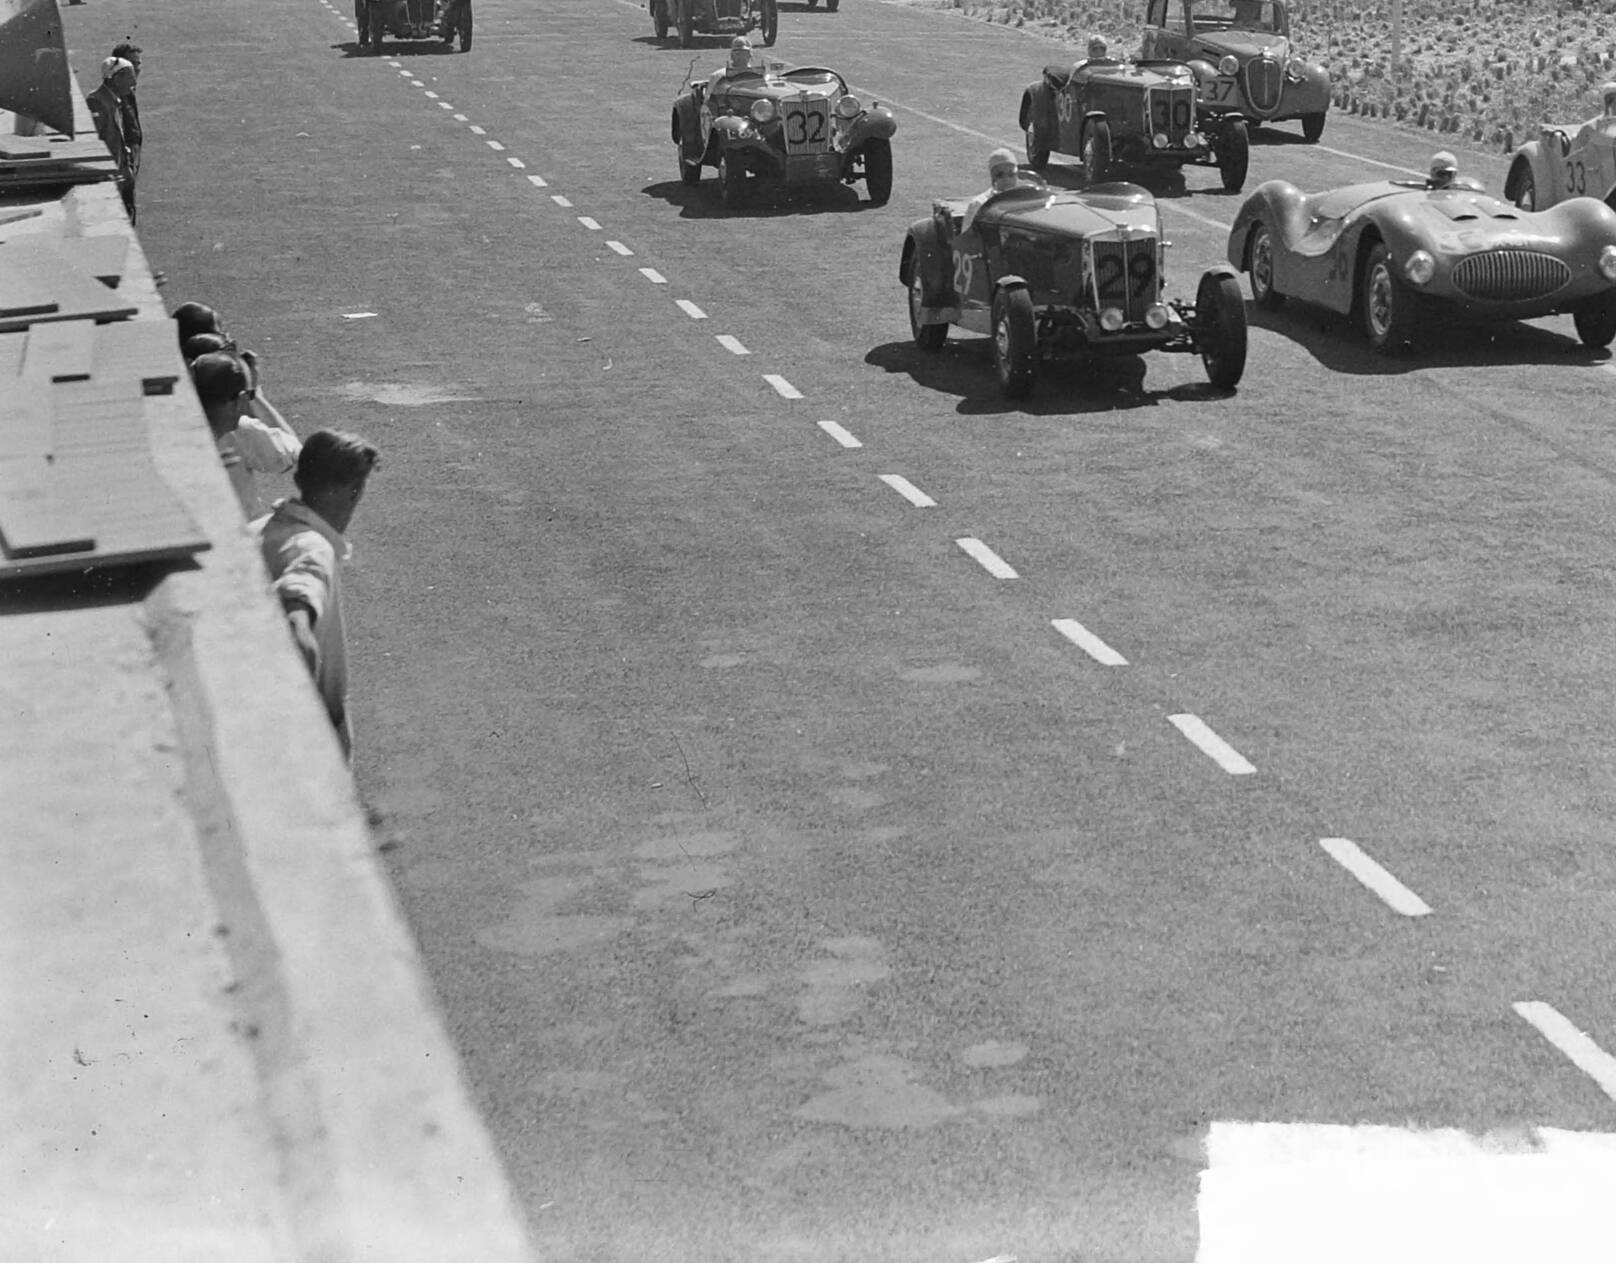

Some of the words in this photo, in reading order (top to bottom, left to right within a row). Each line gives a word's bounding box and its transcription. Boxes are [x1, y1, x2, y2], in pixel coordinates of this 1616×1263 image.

[1057, 92, 1072, 124] 30
[1205, 80, 1235, 102] 37
[787, 110, 825, 144] 32
[1154, 99, 1191, 130] 30
[1566, 161, 1586, 195] 33
[952, 249, 973, 296] 29
[1099, 252, 1155, 299] 29
